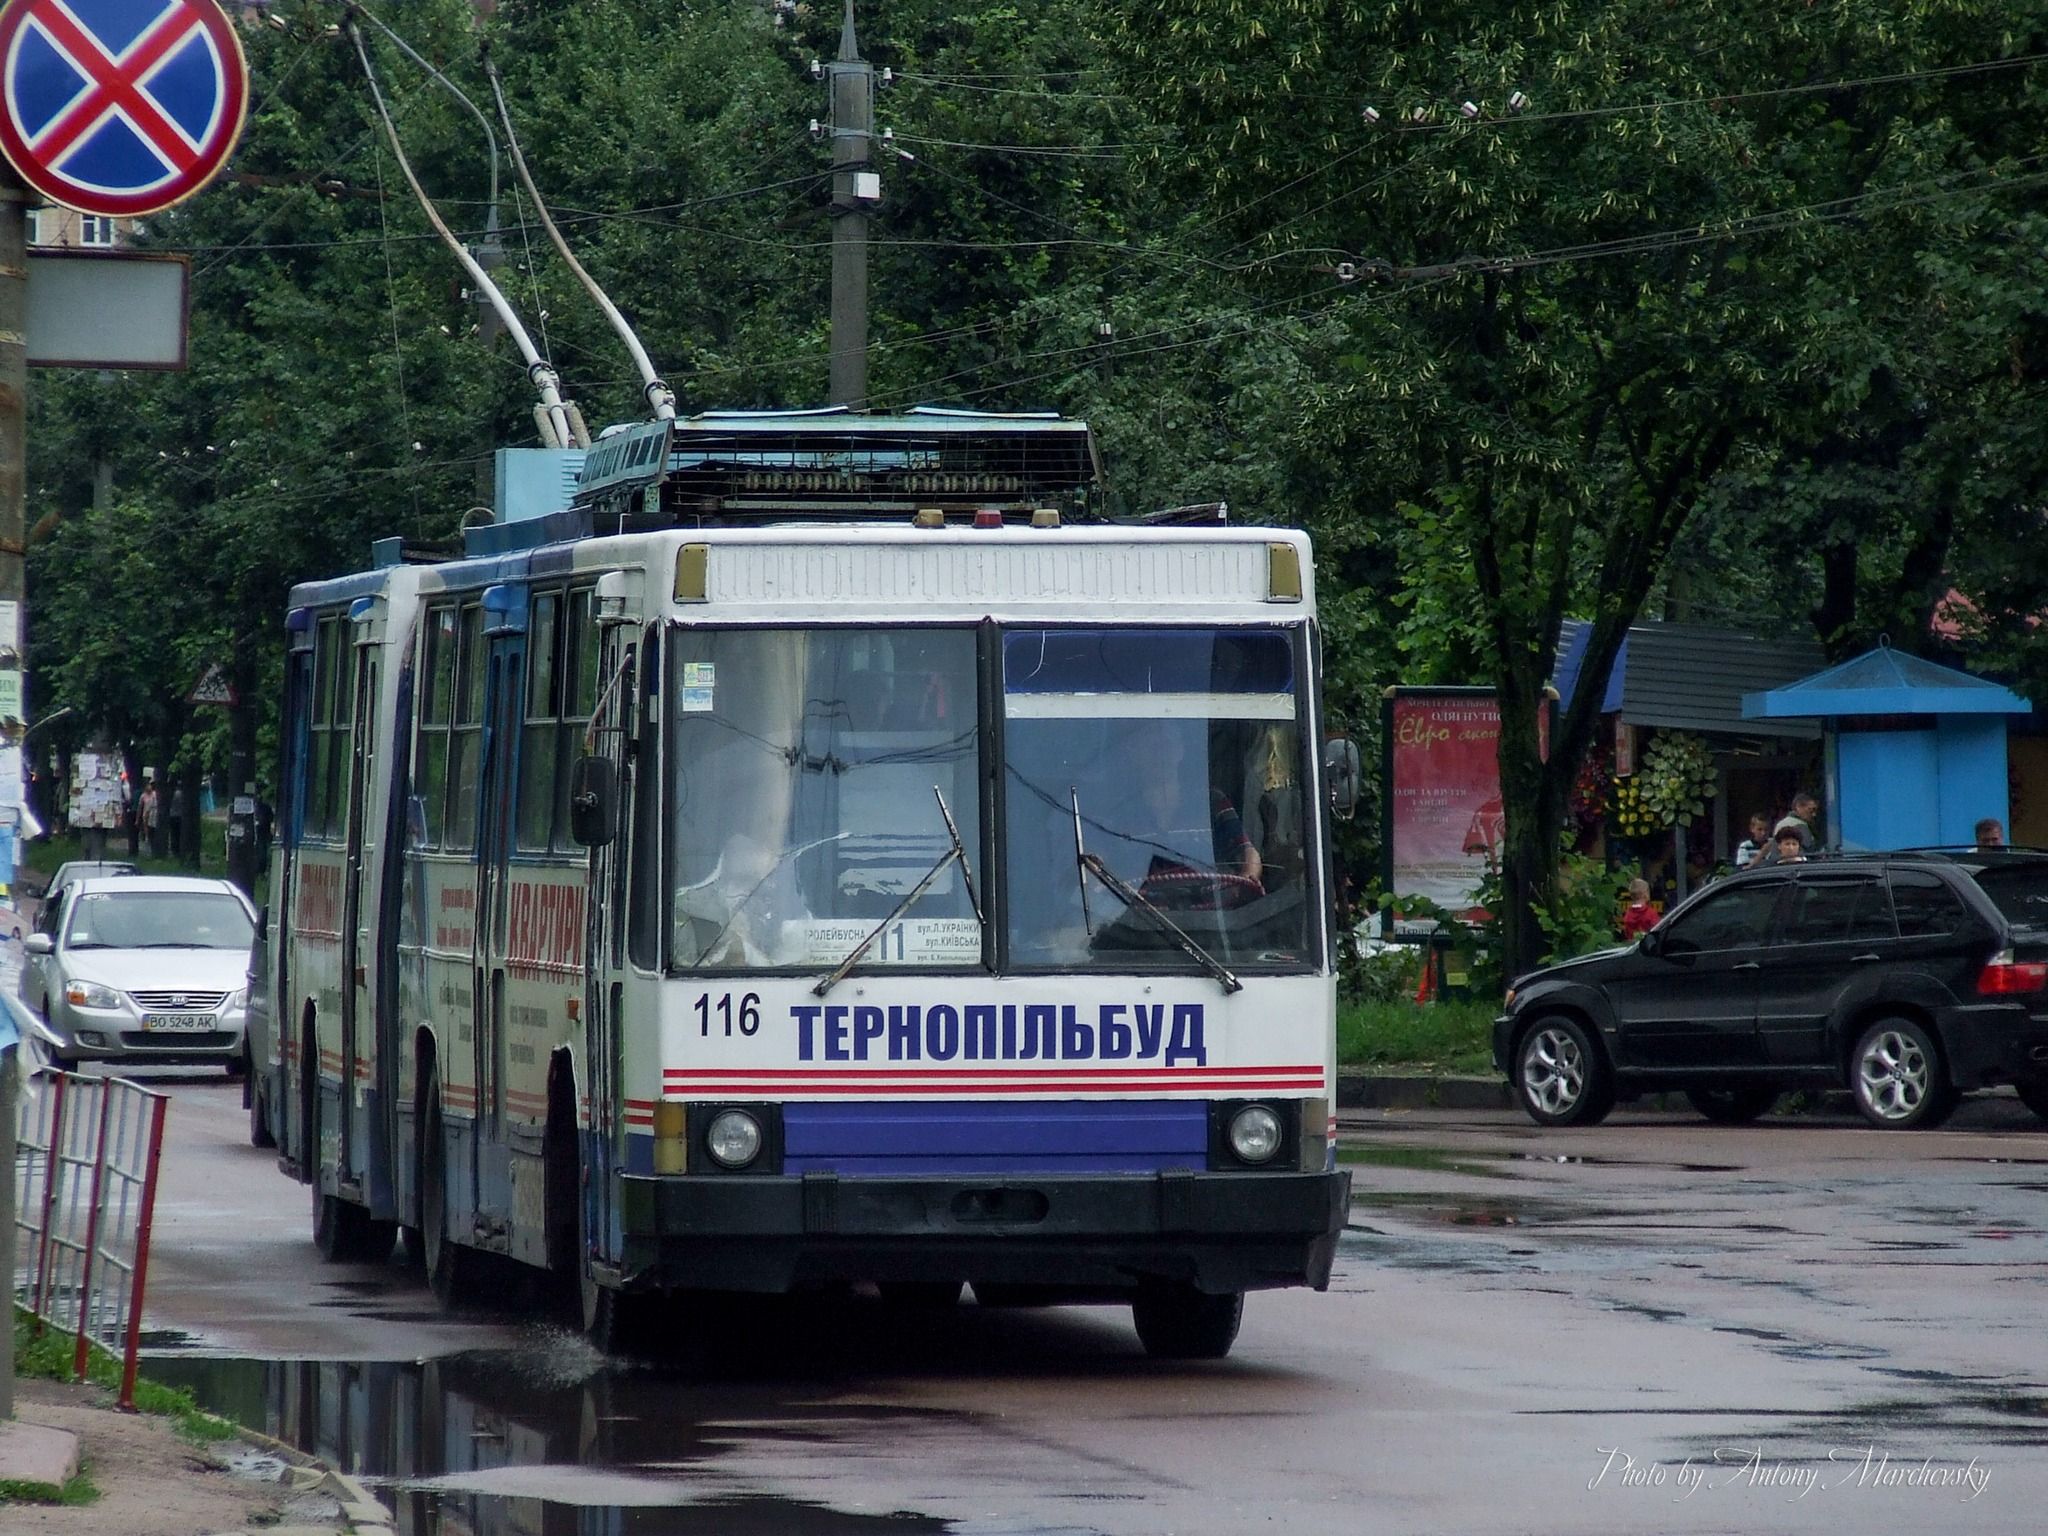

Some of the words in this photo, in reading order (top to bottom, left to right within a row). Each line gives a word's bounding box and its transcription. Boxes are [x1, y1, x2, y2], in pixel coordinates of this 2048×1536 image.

[508, 883, 585, 987] КВАРТИРИ
[805, 927, 866, 941] РОЛЕЙБУСНА
[880, 922, 904, 960] 11
[169, 1016, 194, 1028] 5248
[694, 993, 760, 1037] 116
[790, 1003, 1206, 1067] ТЕРНОПІЛЬБУД
